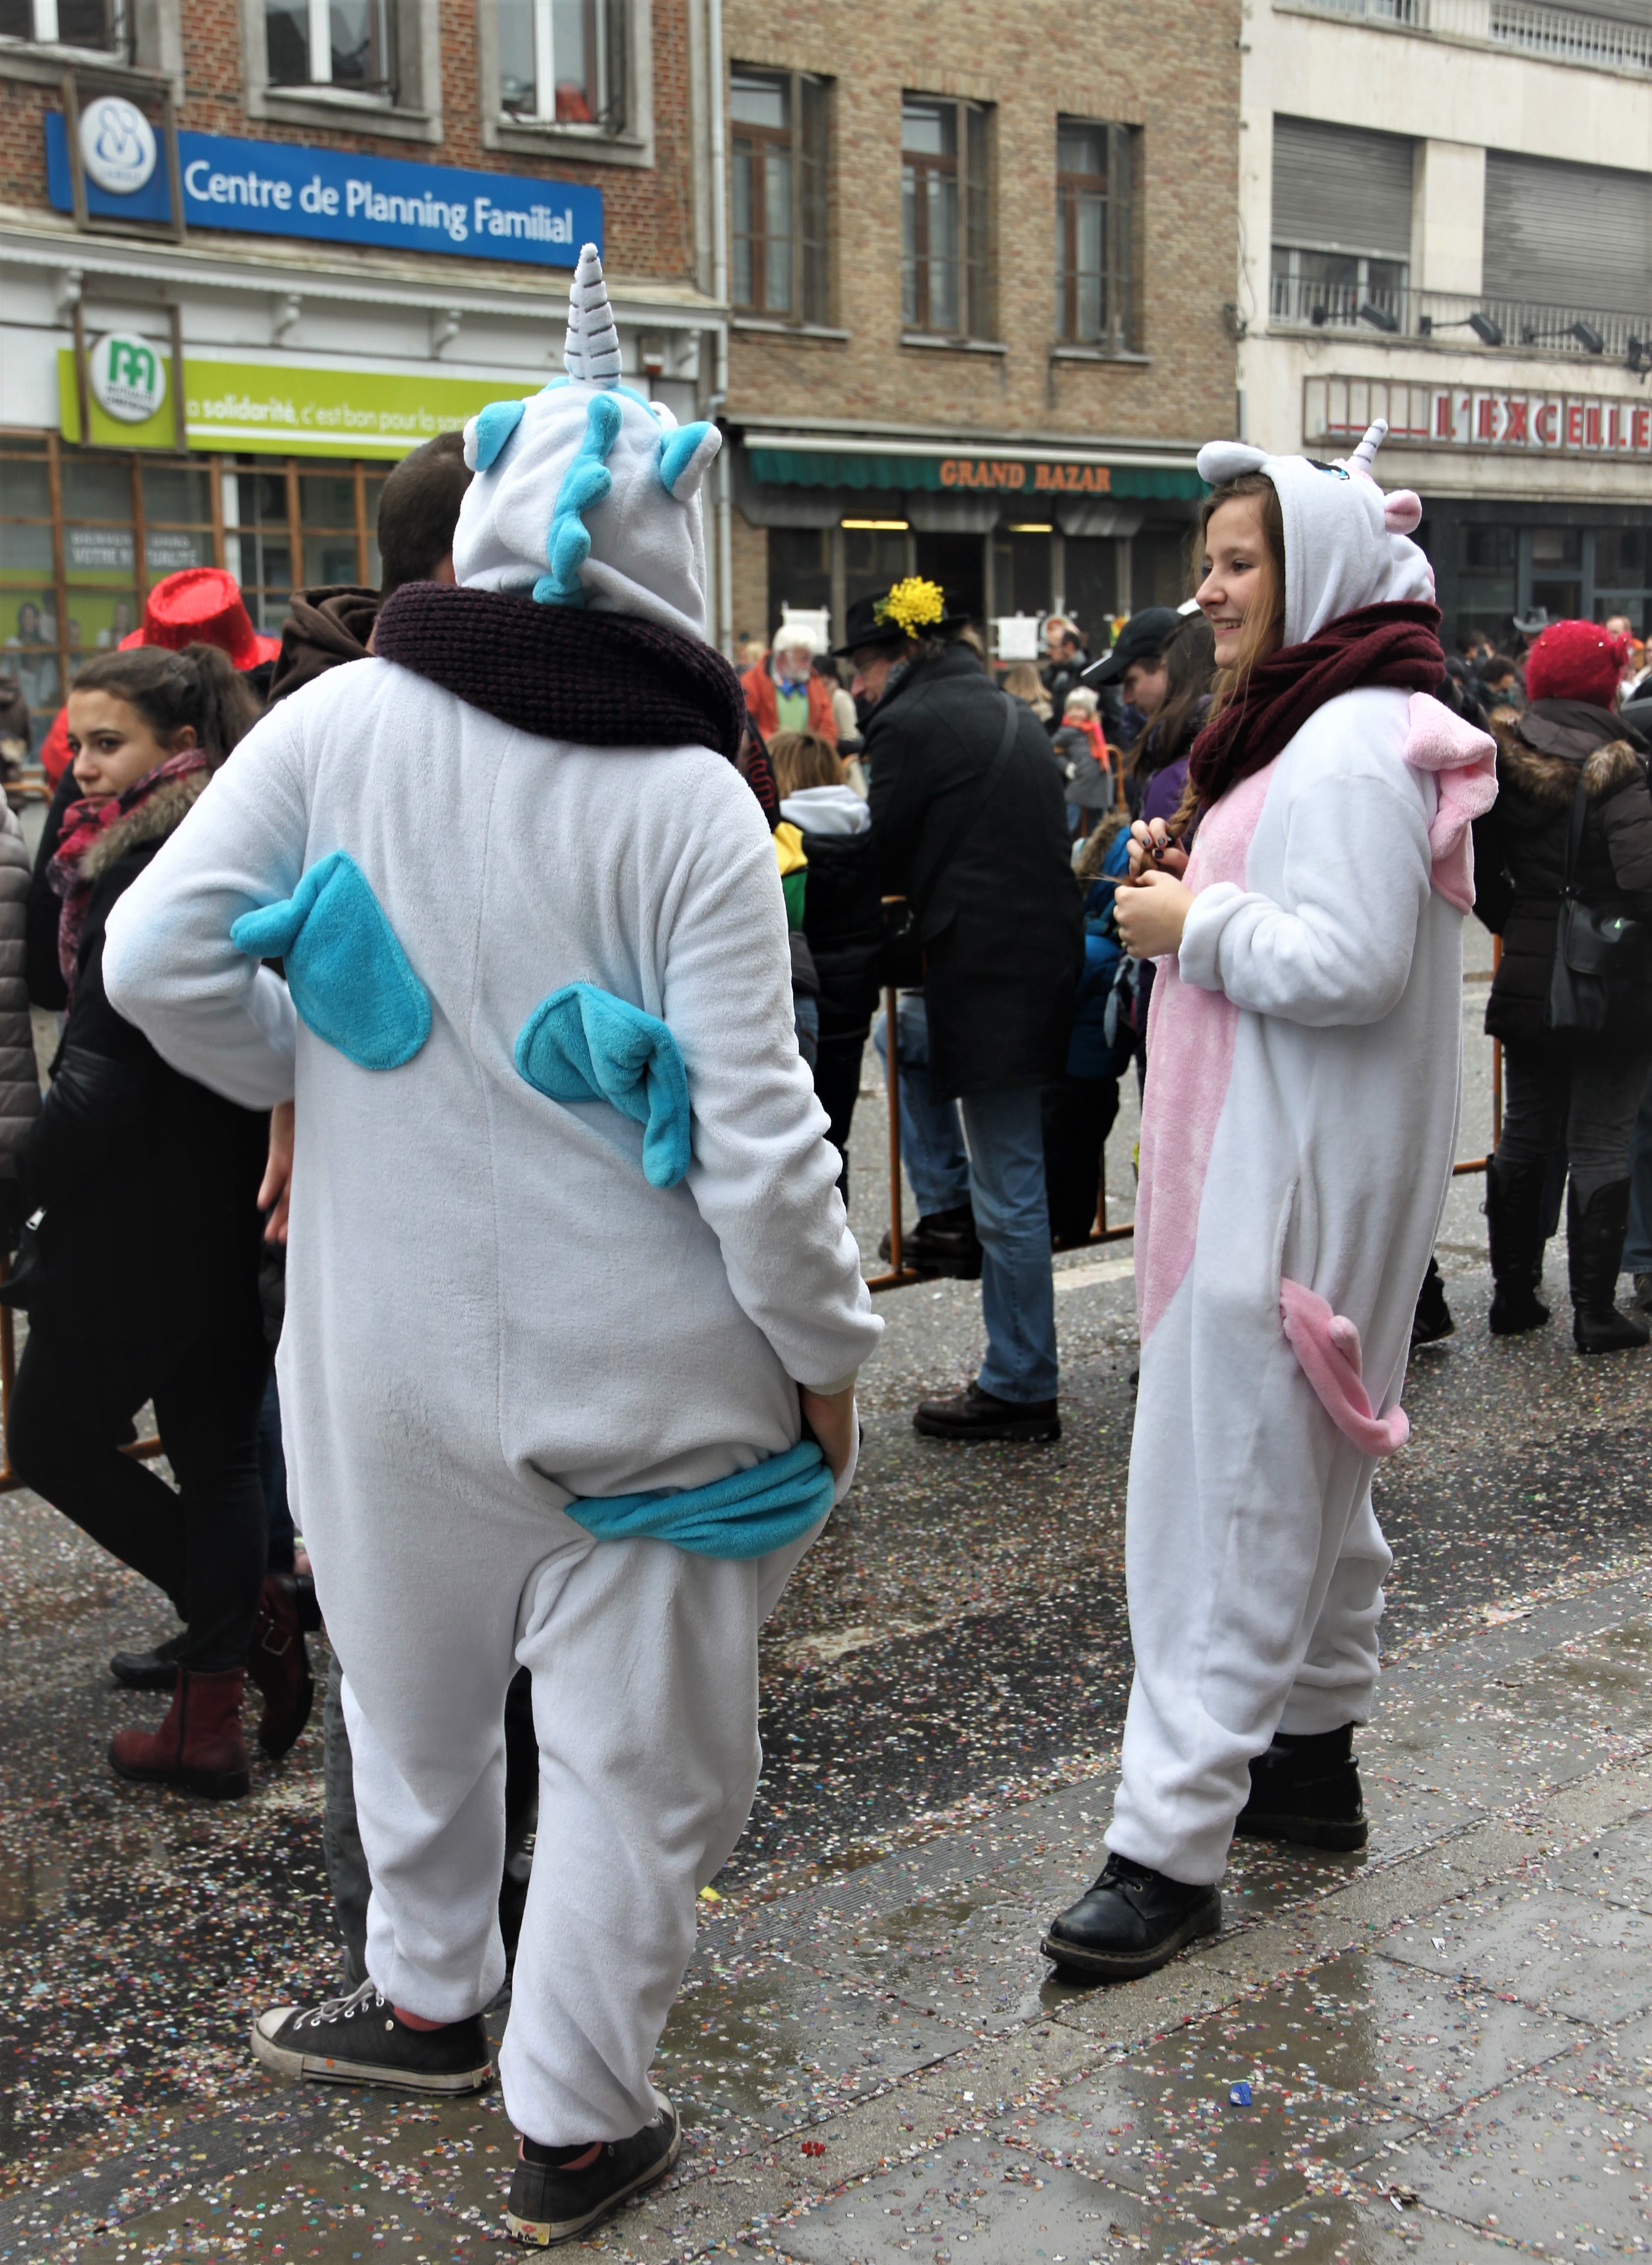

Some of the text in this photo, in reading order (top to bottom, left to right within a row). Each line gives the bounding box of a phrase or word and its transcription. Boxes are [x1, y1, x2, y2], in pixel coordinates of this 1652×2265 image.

[184, 159, 573, 244] Centre de Planning Familial
[342, 401, 378, 428] bon
[379, 410, 417, 434] pour
[418, 405, 436, 432] la
[939, 459, 1111, 492] GRAND BAZAR
